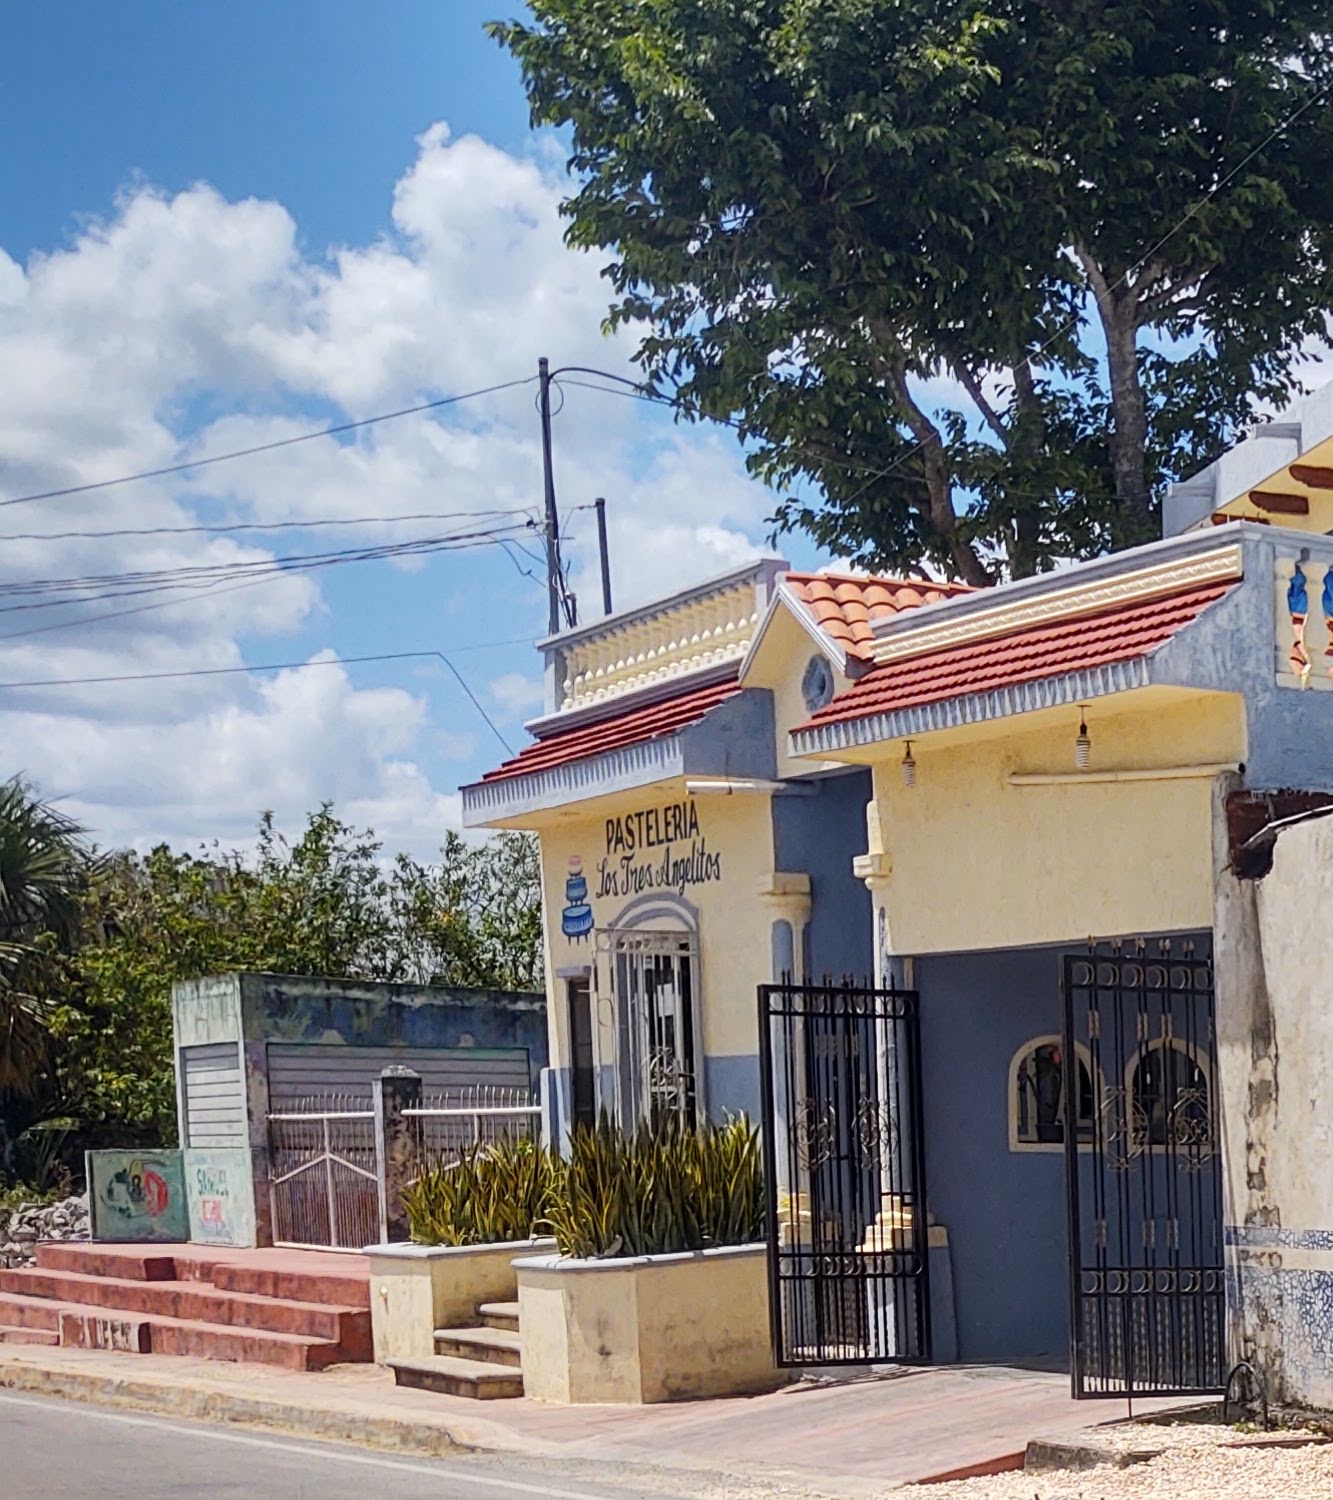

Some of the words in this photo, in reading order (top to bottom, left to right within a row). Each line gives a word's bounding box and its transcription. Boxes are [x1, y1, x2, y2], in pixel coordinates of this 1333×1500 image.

[606, 801, 699, 855] PASTELERIA
[596, 858, 619, 898] Los
[621, 852, 653, 895] Tres
[656, 837, 721, 896] Angelitos
